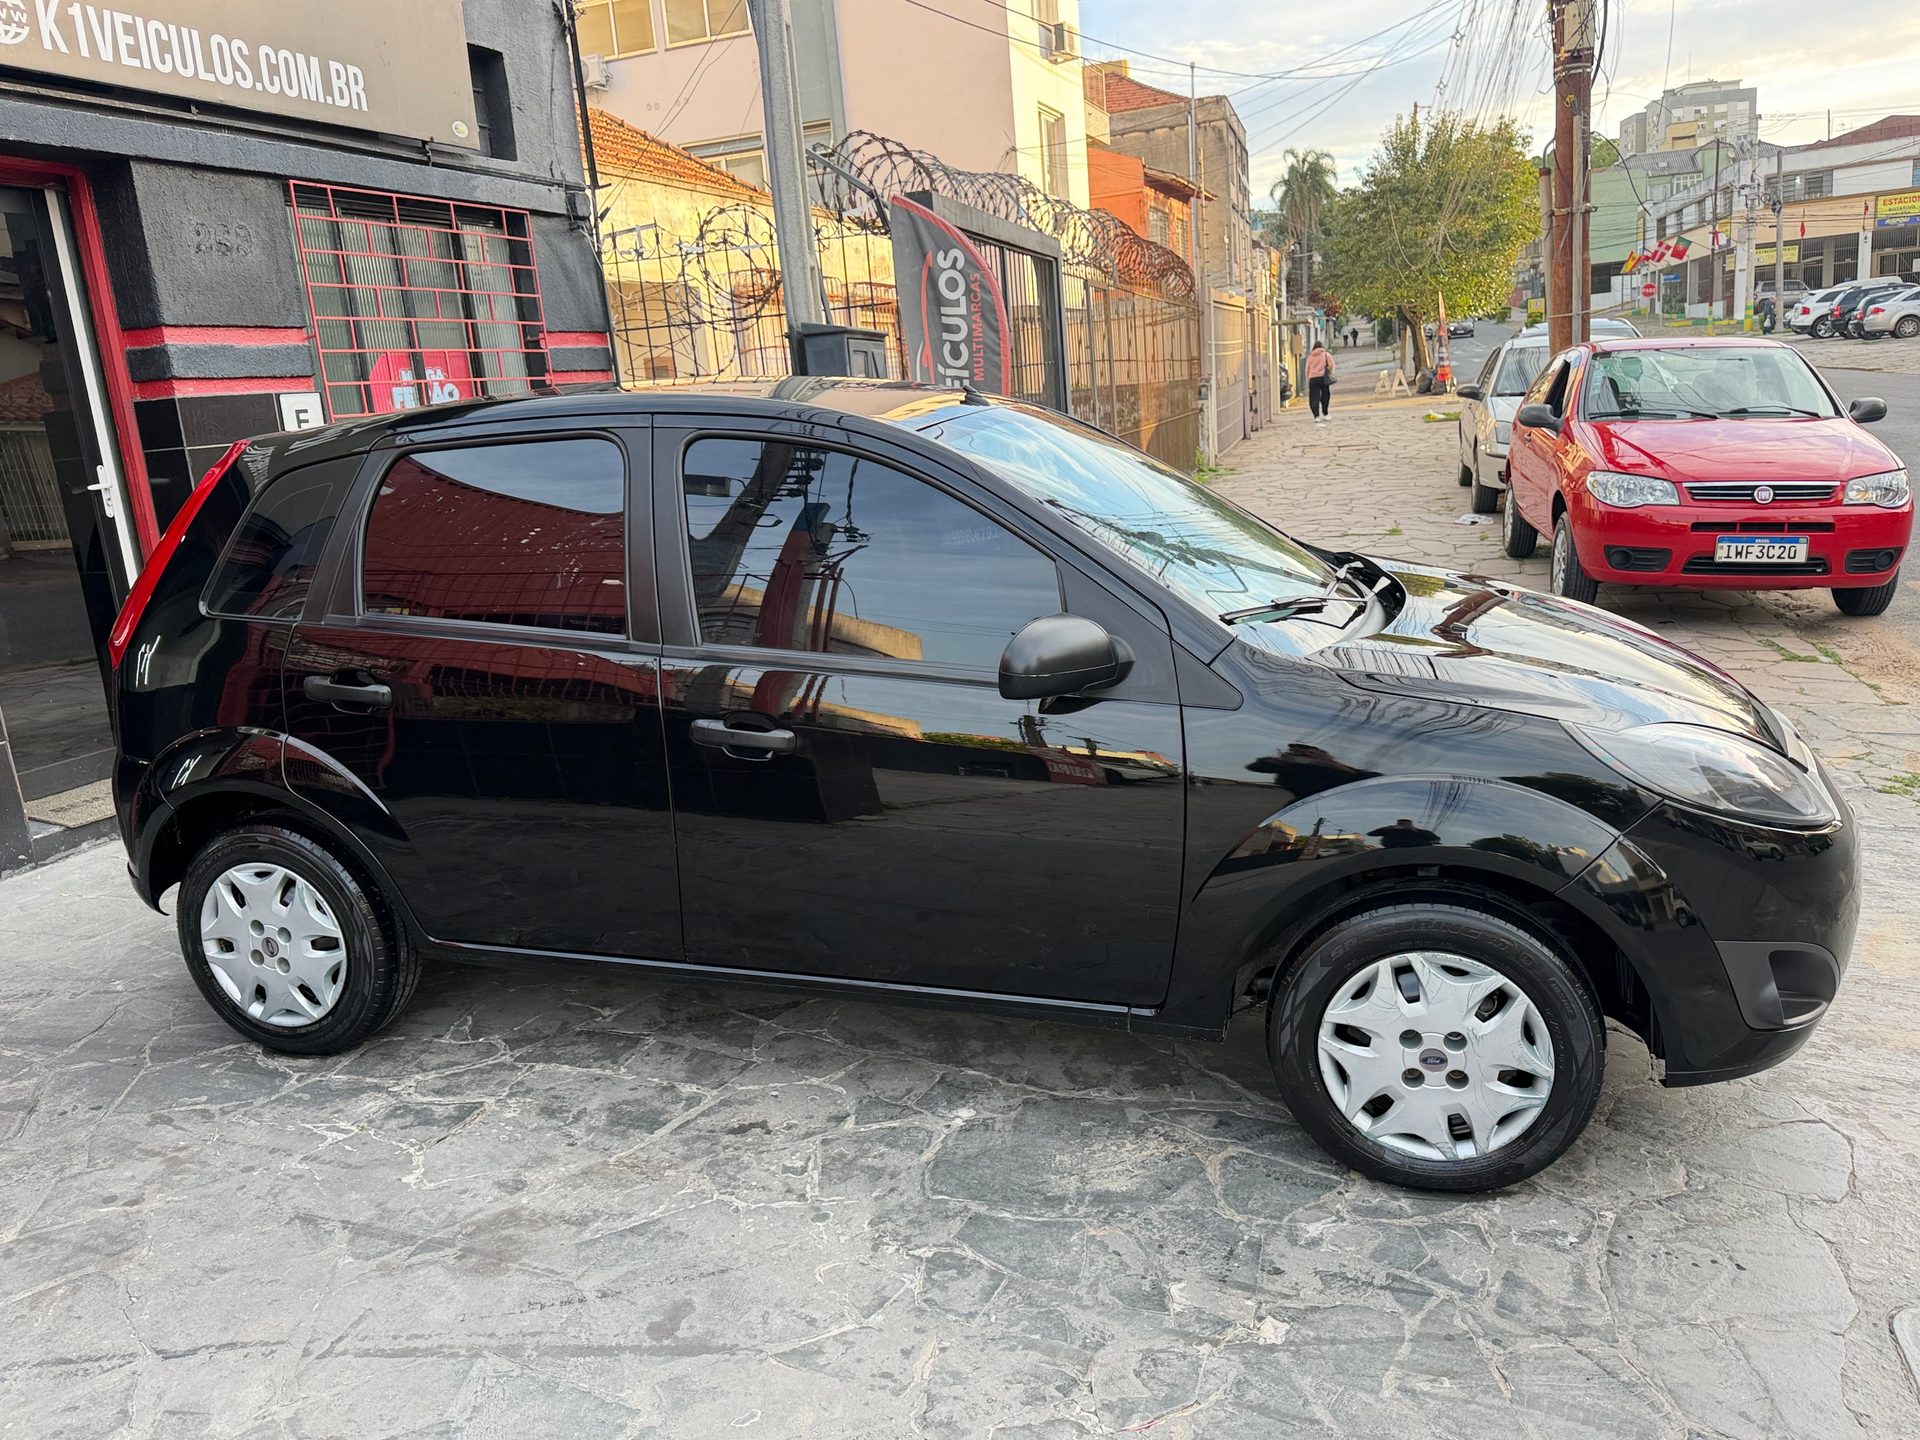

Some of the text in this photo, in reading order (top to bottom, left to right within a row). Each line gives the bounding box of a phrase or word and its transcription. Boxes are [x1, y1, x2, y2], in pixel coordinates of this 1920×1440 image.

[34, 0, 369, 112] K1VEICULOS.COM.BR
[969, 272, 985, 381] MULTIMARCAS
[1723, 544, 1798, 560] IWF3C20
